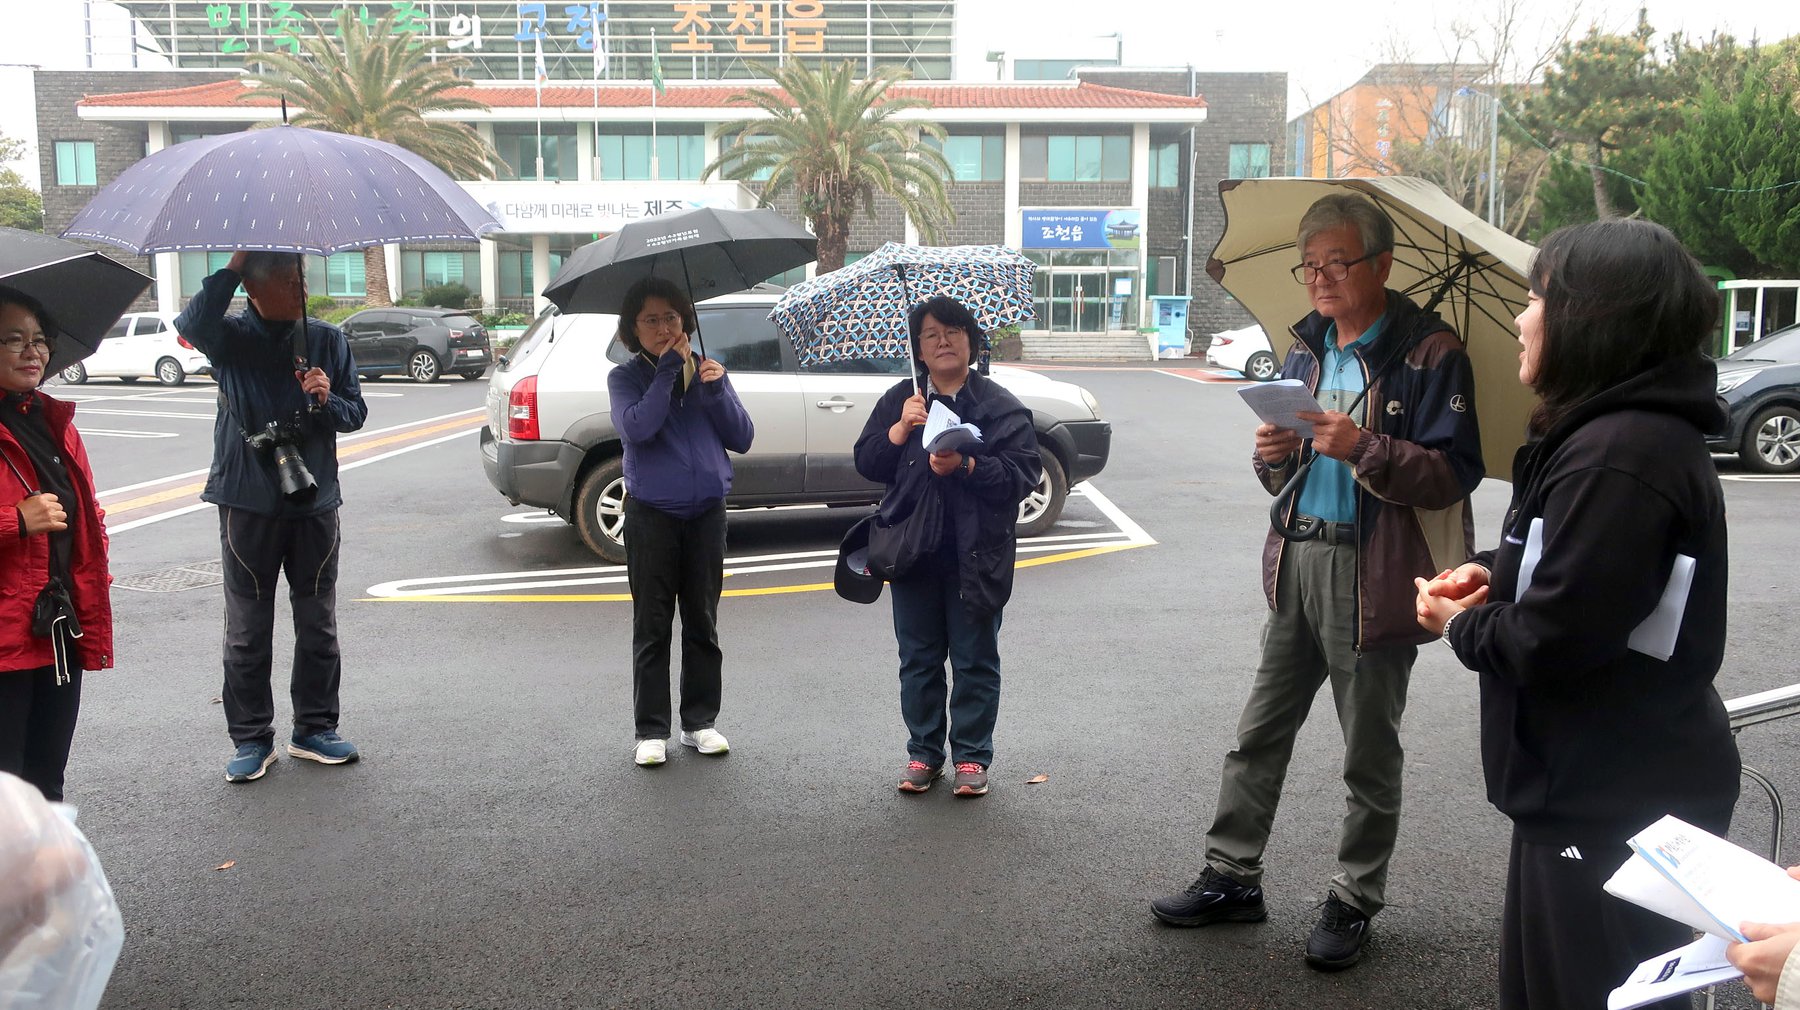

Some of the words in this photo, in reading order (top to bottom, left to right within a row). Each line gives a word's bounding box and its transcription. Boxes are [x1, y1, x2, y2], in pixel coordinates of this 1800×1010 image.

[205, 1, 306, 55] 민족
[512, 3, 608, 50] 고장
[670, 0, 828, 53] 조천읍
[505, 202, 548, 219] 다함께
[551, 202, 594, 219] 미래로
[597, 202, 639, 219] 빛나는
[1041, 224, 1083, 242] 조천읍
